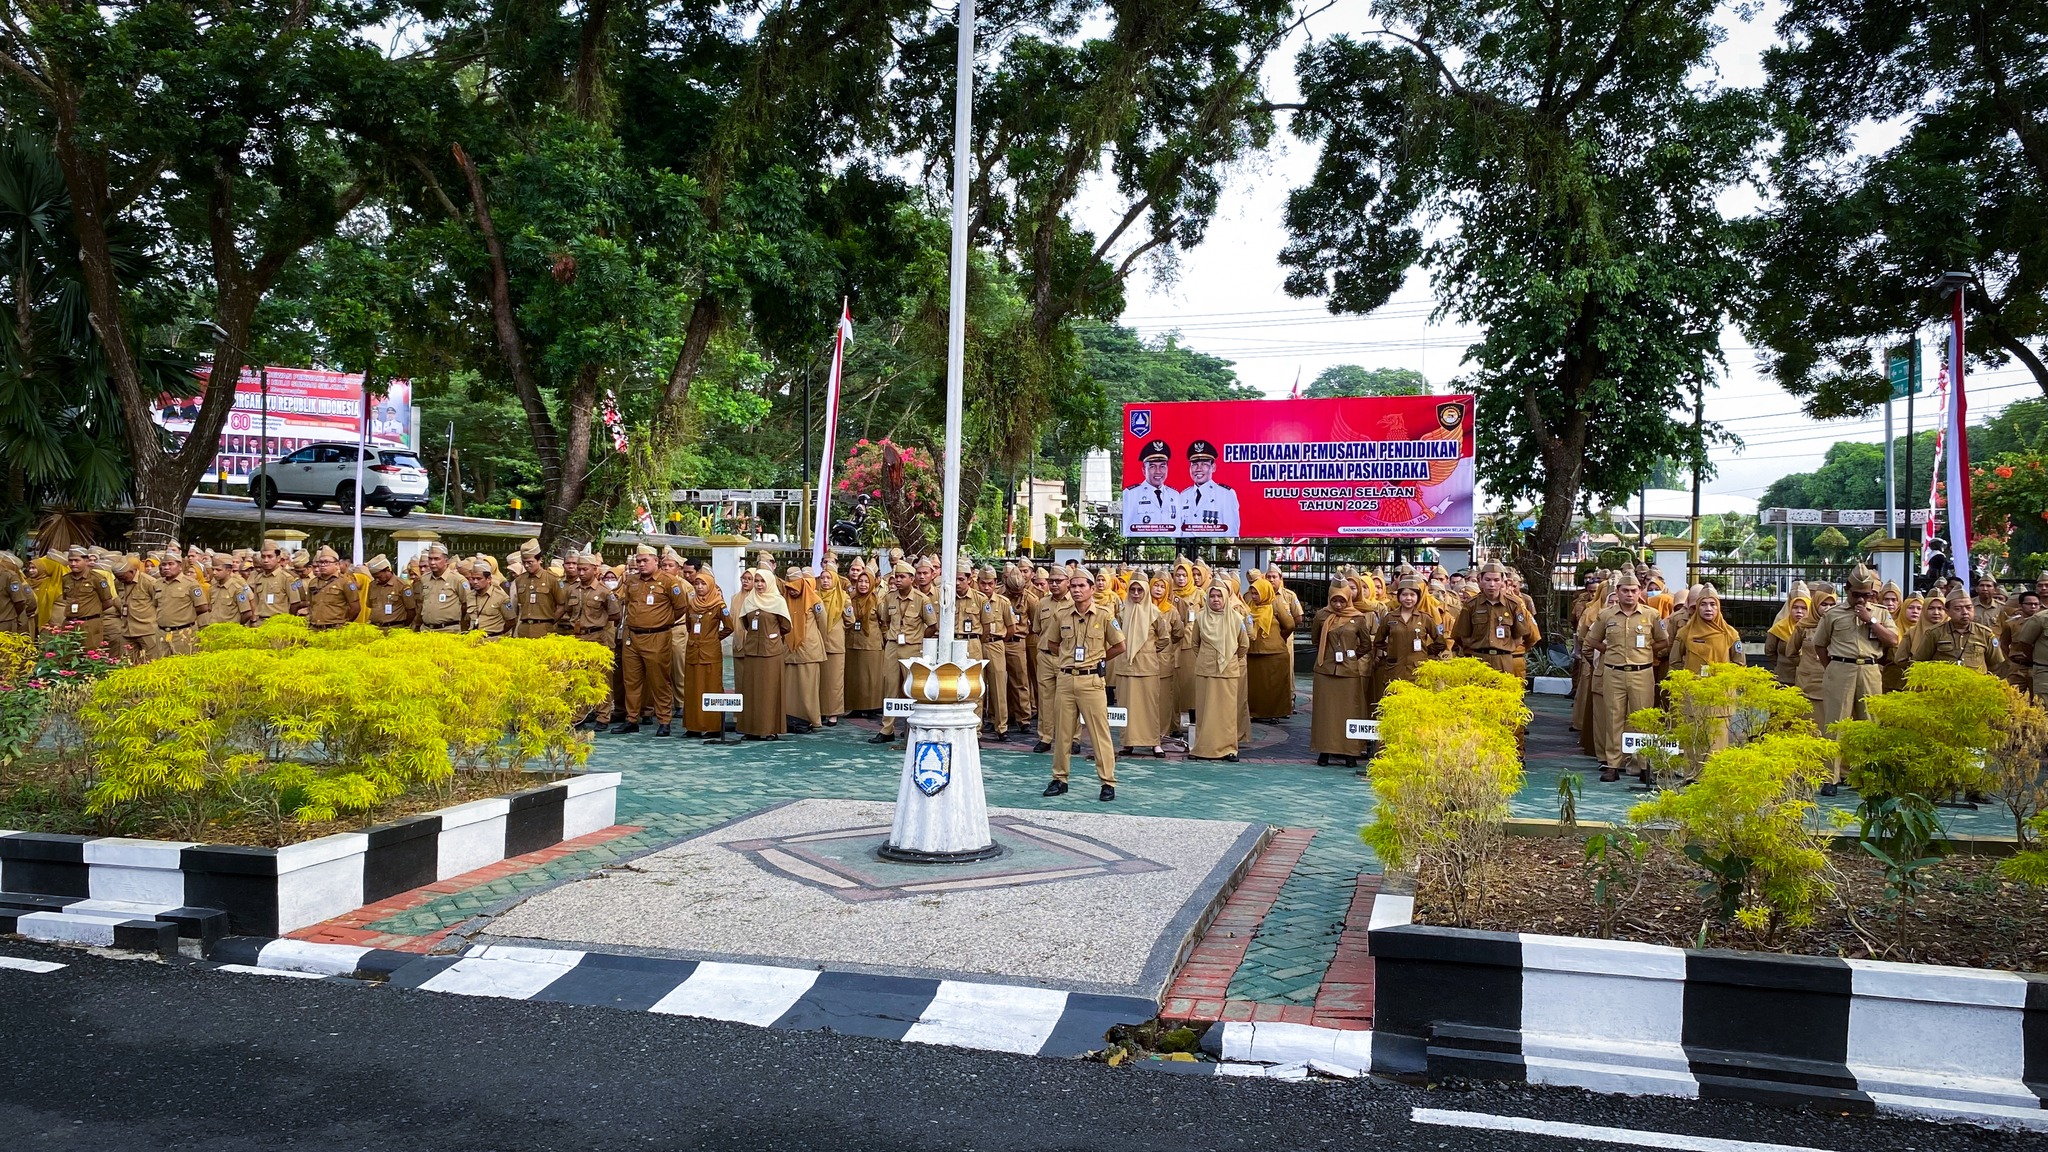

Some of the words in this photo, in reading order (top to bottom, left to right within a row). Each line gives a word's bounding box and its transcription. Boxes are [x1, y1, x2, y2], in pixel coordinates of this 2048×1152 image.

[231, 392, 277, 412] IRGAHYU
[278, 395, 317, 414] REPUBLIK
[319, 399, 360, 417] INDONESIA
[1224, 444, 1300, 461] PEMBUKAAN
[1303, 442, 1377, 460] PEMUSATAN
[1380, 441, 1458, 459] PENDIDIKAN
[1251, 464, 1276, 480] DAN
[1279, 463, 1344, 480] PELATIHAN
[1347, 462, 1429, 479] PASKIBRAKA
[1264, 488, 1299, 497] HULU
[1303, 487, 1352, 497] SUNGAI
[1356, 487, 1414, 497] SELATAN
[1300, 501, 1343, 510] TAHUN
[1347, 500, 1378, 510] 2025
